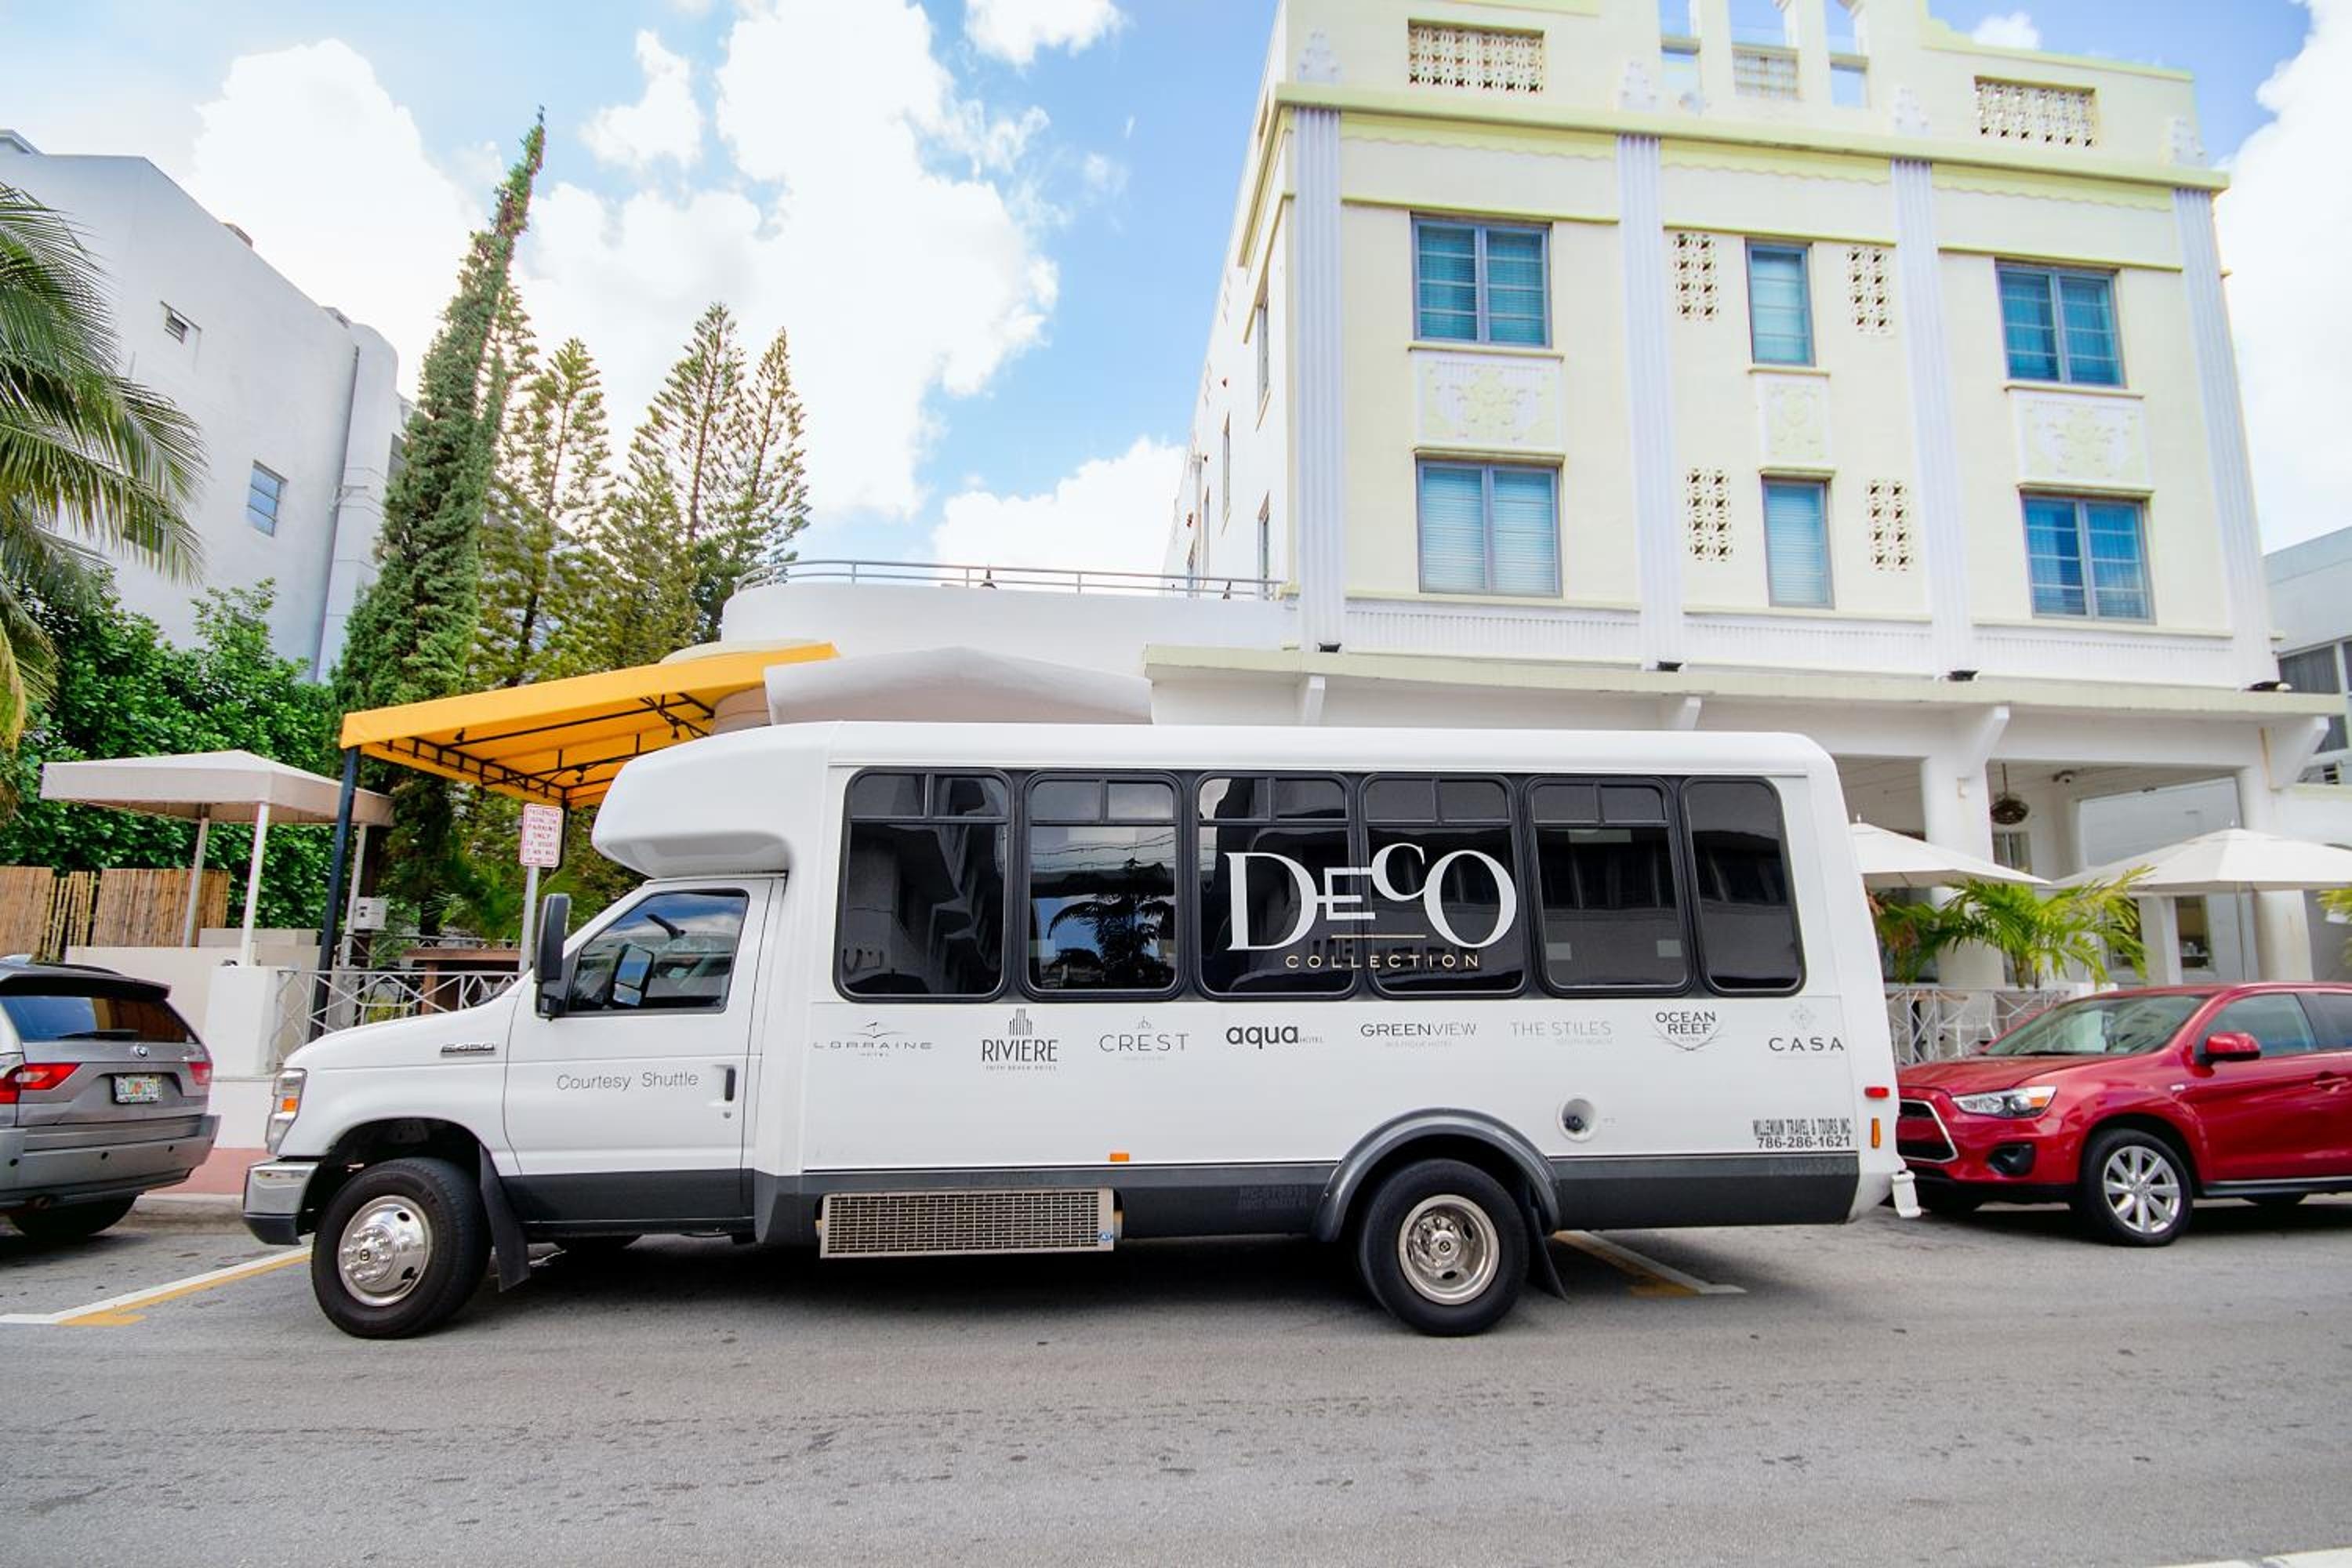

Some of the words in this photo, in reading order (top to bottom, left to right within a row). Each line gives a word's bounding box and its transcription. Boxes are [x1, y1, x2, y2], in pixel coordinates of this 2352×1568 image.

[1225, 843, 1517, 951] DECO
[1285, 954, 1479, 969] COLLECTION
[1655, 1011, 1716, 1023] OCEAN
[1360, 1022, 1477, 1037] GREENVIEW
[1510, 1021, 1544, 1036] THE
[1552, 1021, 1612, 1036] STILES
[1668, 1023, 1712, 1035] REEF
[813, 1040, 933, 1050] LORRAINE
[1099, 1033, 1190, 1052] CREST
[1225, 1025, 1299, 1050] aqua
[1769, 1036, 1845, 1051] CASA
[982, 1039, 1058, 1062] RIVIERE
[556, 1073, 632, 1092] Courtesy
[641, 1071, 699, 1087] Shuttle
[1786, 1118, 1809, 1135] TRAVEL
[1818, 1118, 1838, 1134] TOURS
[1756, 1136, 1851, 1149] 786-286-1621
